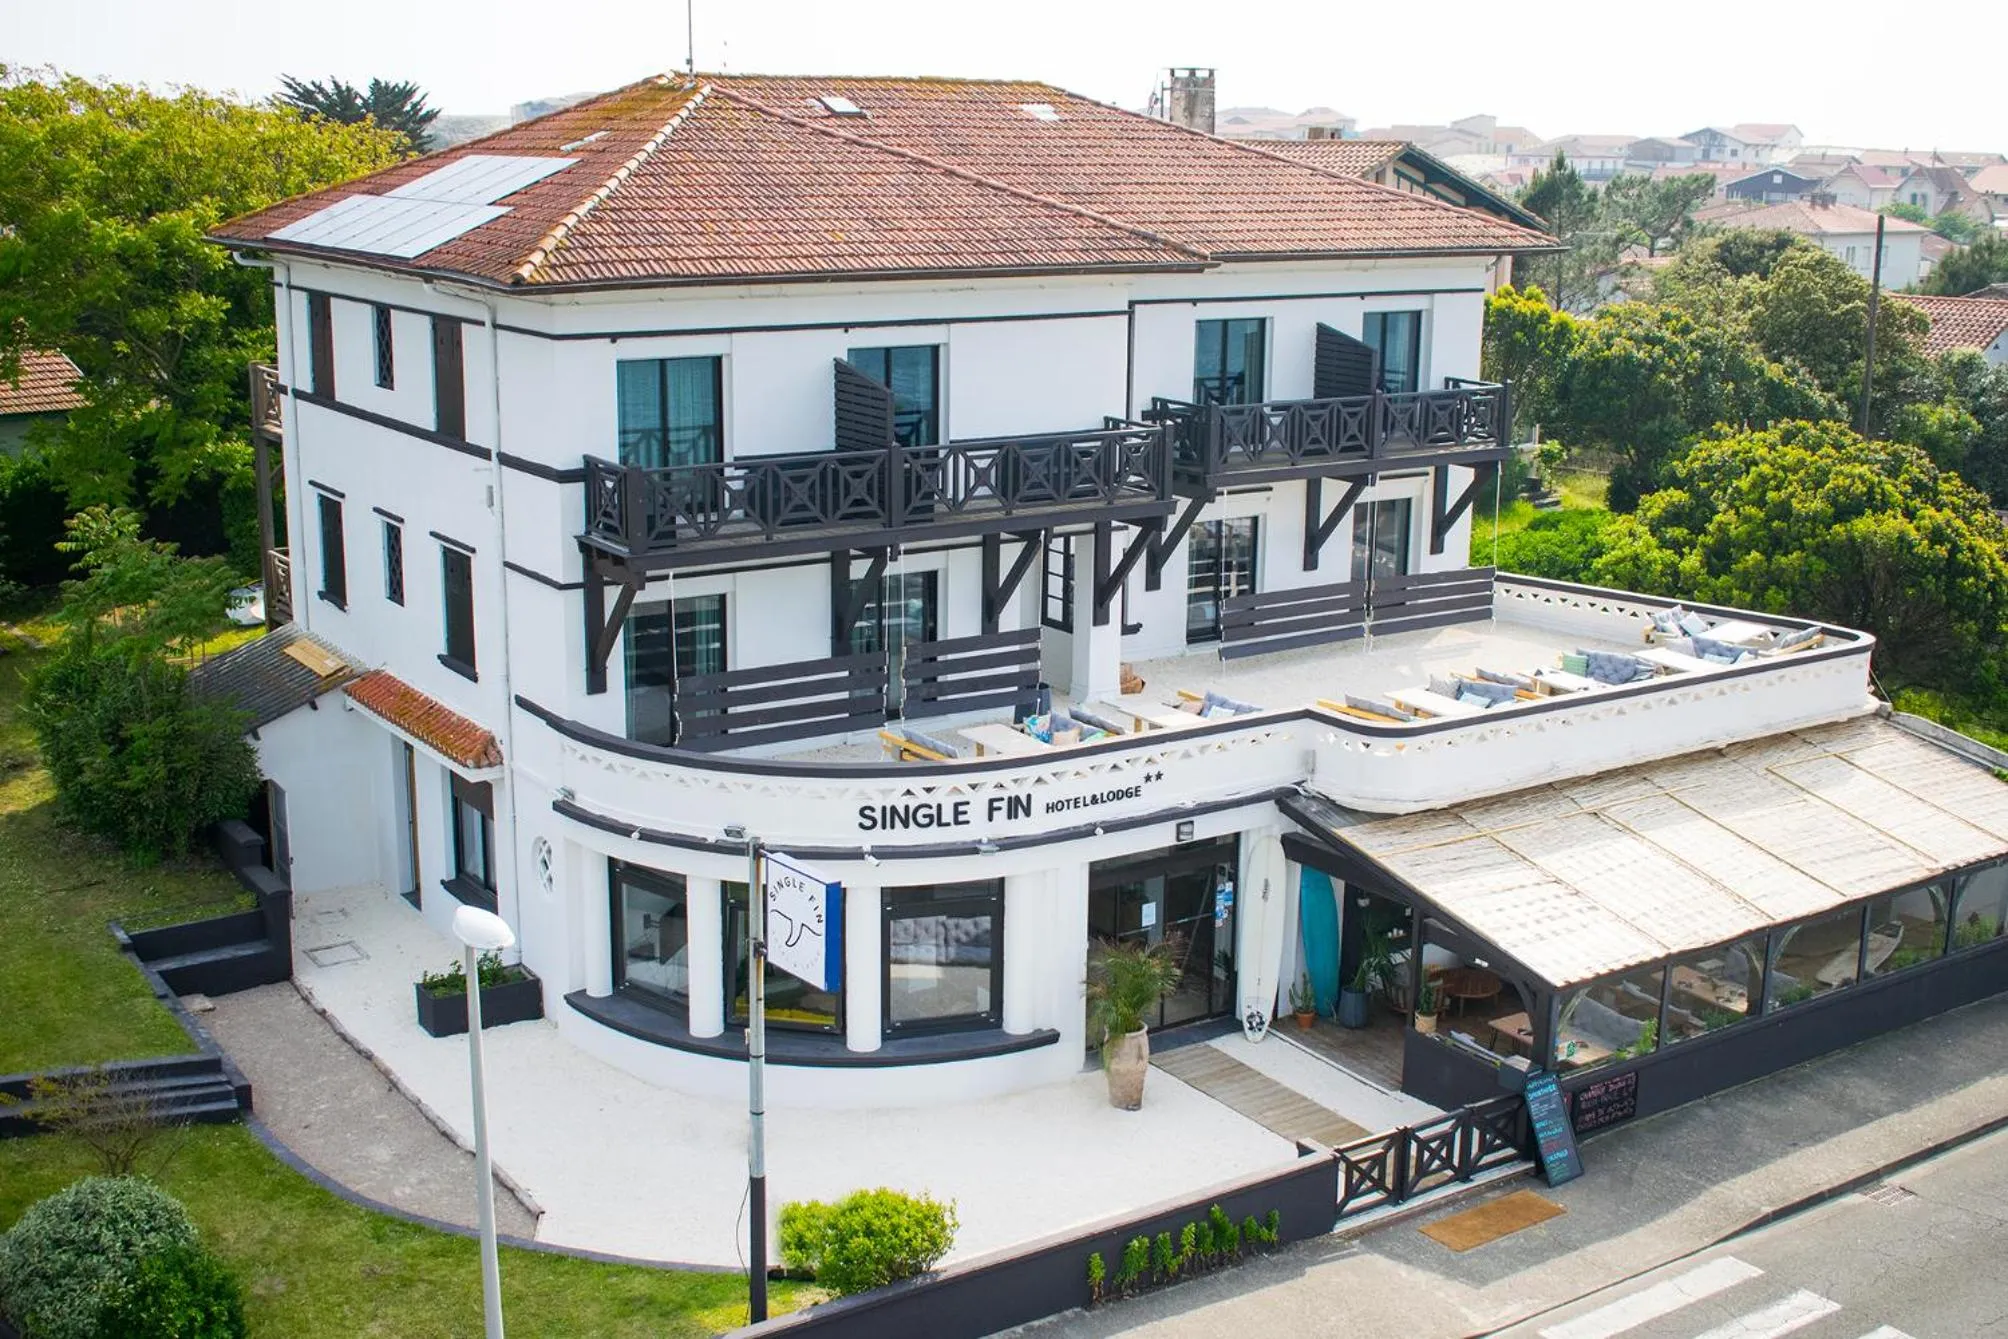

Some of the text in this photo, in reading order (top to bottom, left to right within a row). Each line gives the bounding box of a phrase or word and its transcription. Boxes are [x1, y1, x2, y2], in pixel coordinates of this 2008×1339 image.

[858, 801, 970, 831] SINGLE
[987, 793, 1032, 822] FIN
[769, 876, 824, 924] SINGLE FIN
